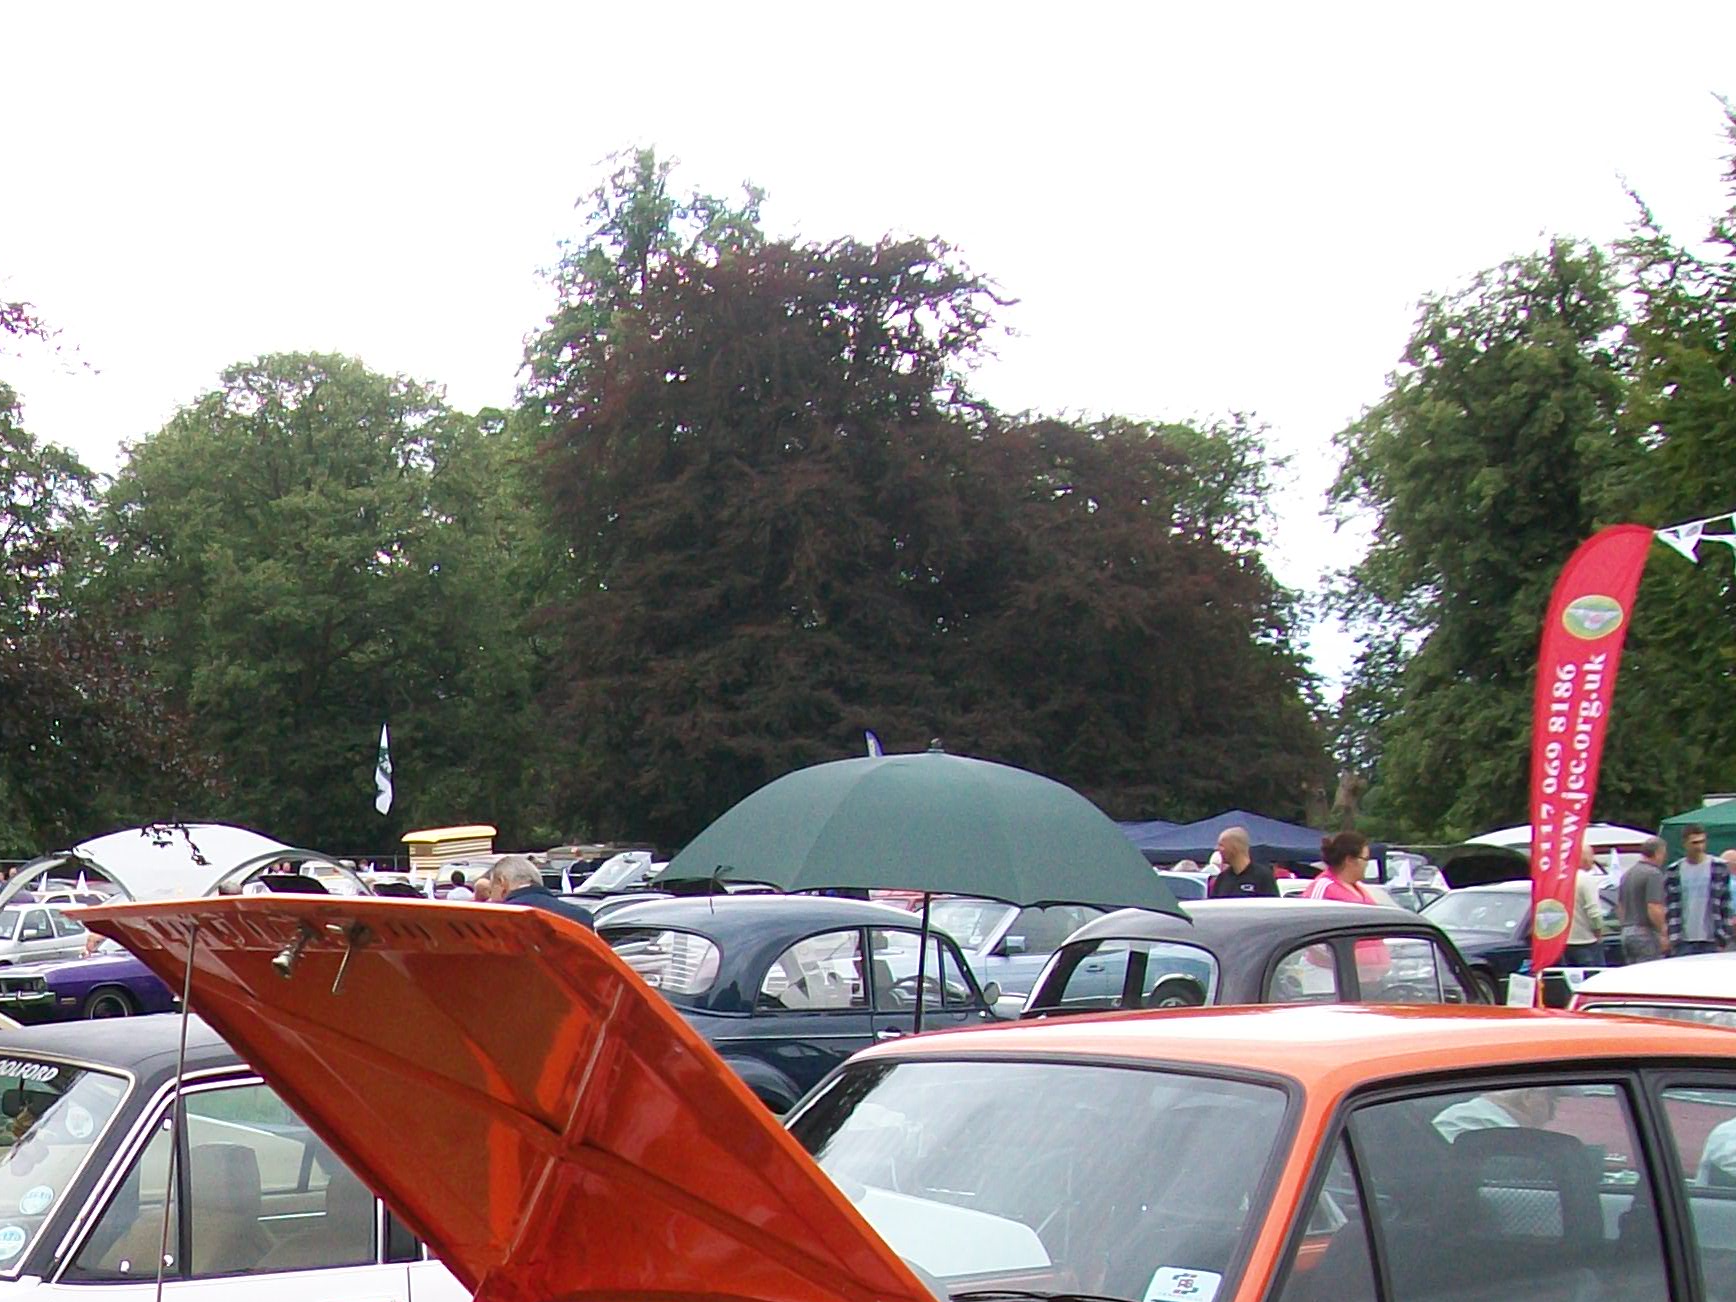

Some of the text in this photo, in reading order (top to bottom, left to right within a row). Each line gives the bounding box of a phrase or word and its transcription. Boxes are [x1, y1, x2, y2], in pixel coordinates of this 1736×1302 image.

[1539, 663, 1577, 871] 0117 069 8186
[1556, 653, 1607, 880] www.jec.org.uk
